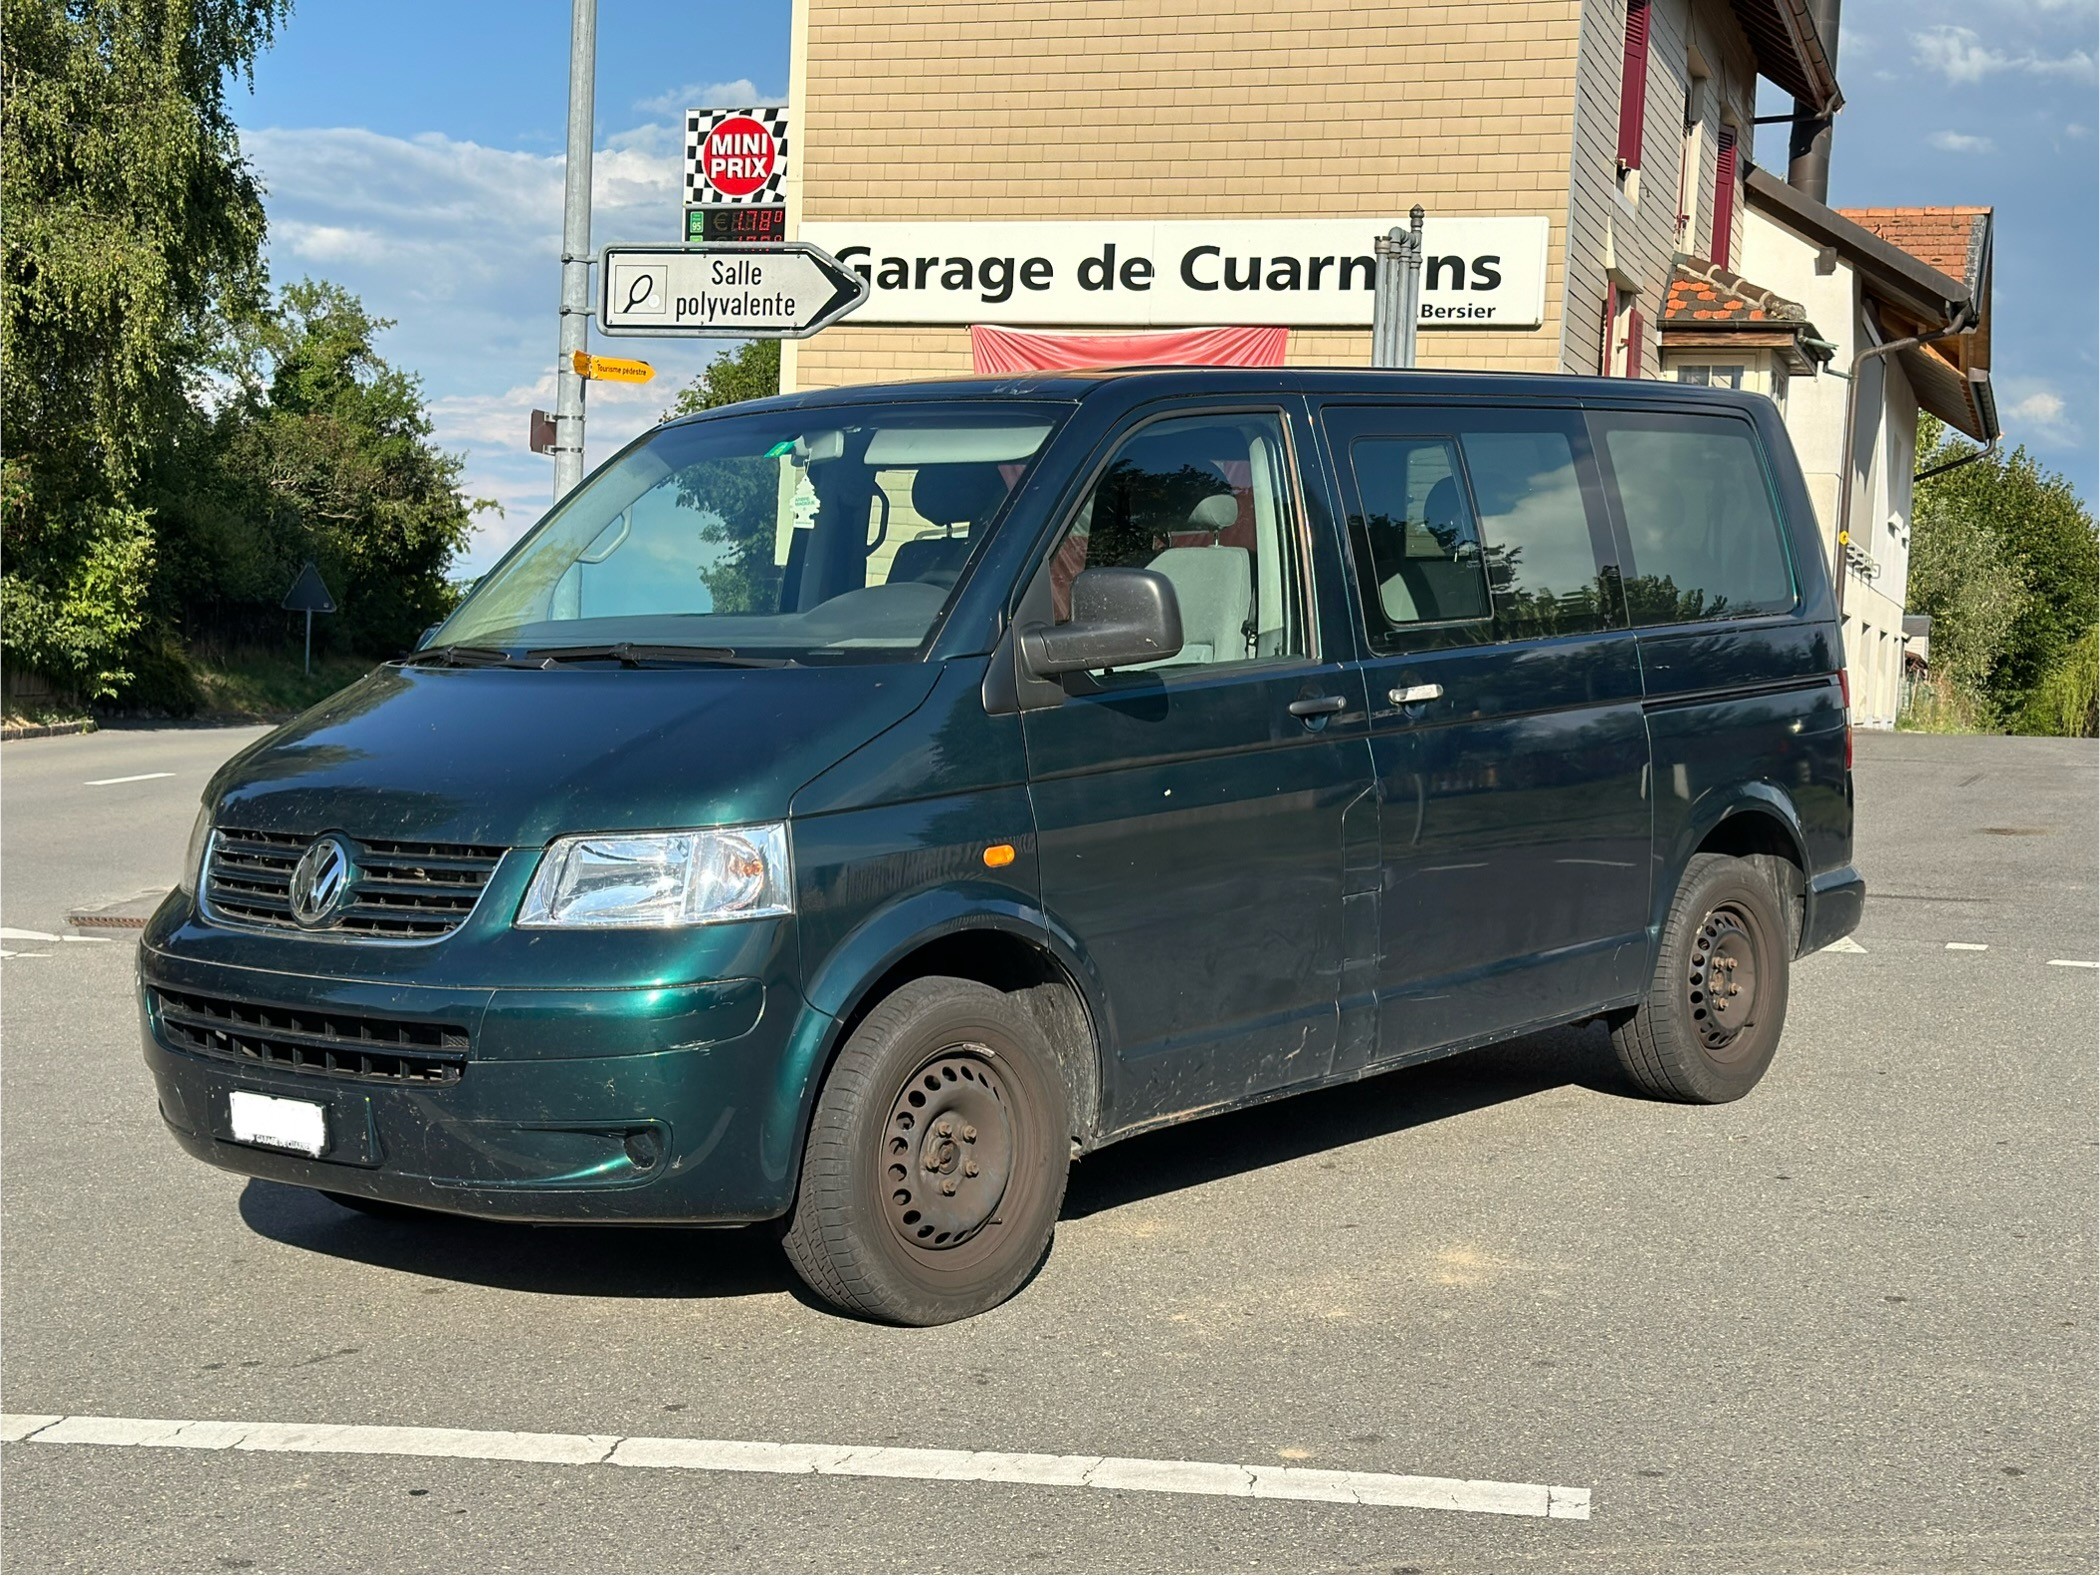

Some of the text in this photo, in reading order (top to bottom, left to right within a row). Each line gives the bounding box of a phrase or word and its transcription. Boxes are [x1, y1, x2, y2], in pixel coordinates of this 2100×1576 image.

[711, 133, 768, 155] MINI
[710, 157, 768, 178] PRIX
[711, 260, 762, 285] Salle
[834, 243, 1502, 304] Garage de Cuarnns
[676, 291, 795, 322] polyvalente
[597, 363, 646, 376] Tourisme pédestre
